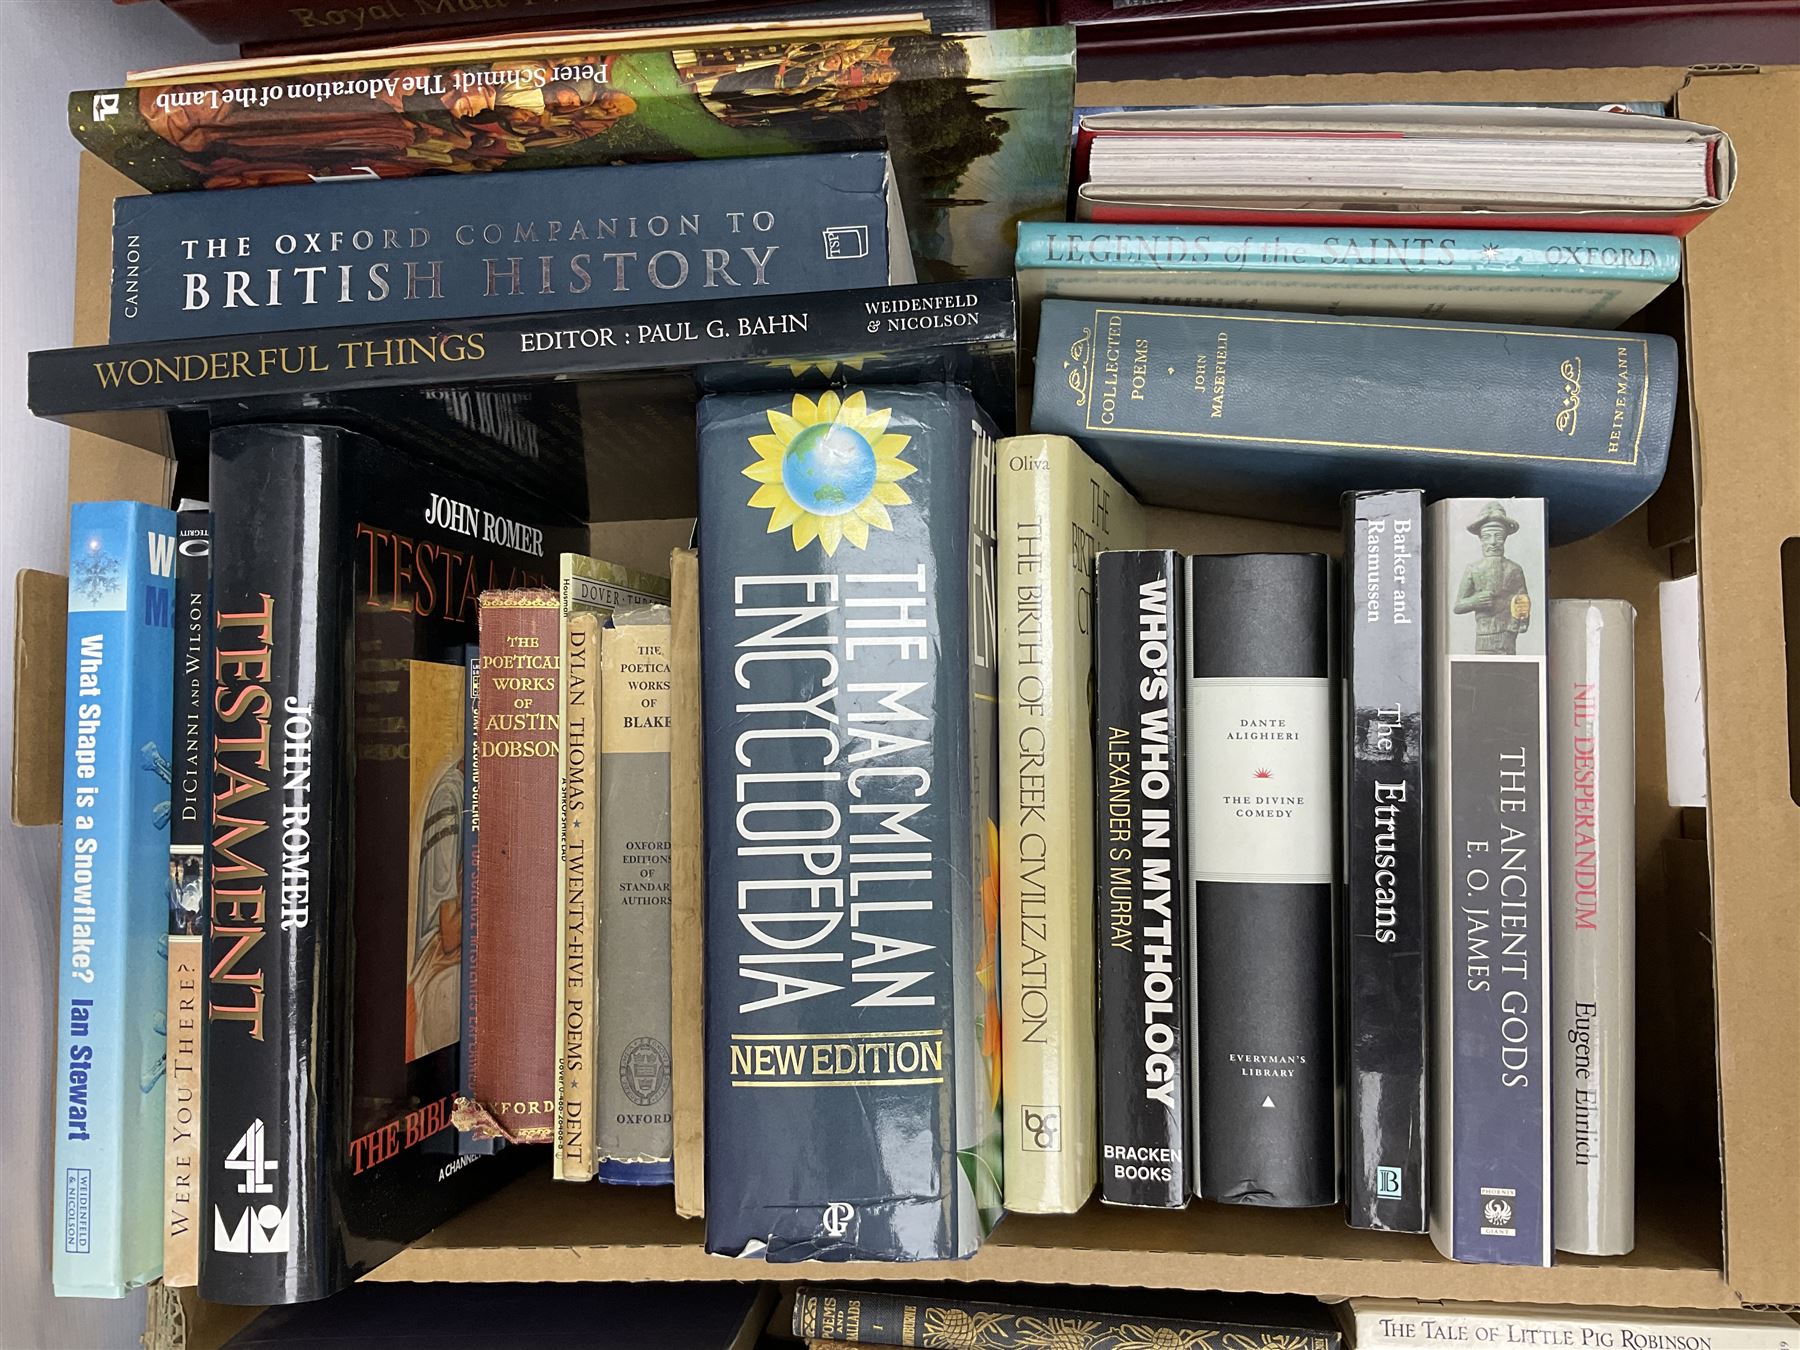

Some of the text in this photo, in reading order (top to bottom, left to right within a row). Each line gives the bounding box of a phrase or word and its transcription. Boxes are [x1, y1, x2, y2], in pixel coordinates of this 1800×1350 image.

[289, 0, 406, 31] Royal
[156, 64, 608, 114] Peter Schmidt The Adoration of the Lamb
[181, 211, 775, 260] THE OXFORD COMPANION TO
[828, 232, 841, 257] TSP
[1046, 233, 1657, 273] LEGENDS of the SAINTS OXFORD
[124, 234, 141, 318] CANNON
[182, 246, 779, 312] BRITISH HISTORY
[864, 294, 979, 316] WEIDENFELD
[866, 312, 980, 333] & NICOLSON
[94, 344, 330, 390] WONDERFUL
[337, 332, 486, 371] THINGS
[520, 326, 618, 353] EDITOR
[638, 320, 699, 344] PAUL
[706, 318, 731, 340] G.
[737, 313, 809, 337] BAHN
[1101, 315, 1123, 425] COLLECTED
[1130, 338, 1149, 401] POEMS
[1194, 354, 1207, 394] JOHN
[1210, 332, 1228, 419] MASEFIELD
[1607, 345, 1627, 455] HEINEMANN
[1009, 456, 1051, 472] Oliva
[424, 492, 545, 558] JOHN ROMER
[1090, 478, 1111, 535] THE
[1366, 518, 1386, 624] Rasmussen
[1393, 518, 1412, 625] Barker and
[563, 578, 571, 619] Housman
[581, 583, 620, 606] DOVER
[507, 636, 540, 649] THE
[638, 646, 662, 656] THE
[492, 677, 555, 691] WORKS
[620, 664, 671, 674] POETICA
[628, 680, 671, 691] WORKS
[182, 592, 202, 821] DICIANNI AND WILSON
[485, 714, 560, 731] AUSTIN
[514, 698, 533, 709] OF
[641, 698, 658, 708] OF
[1240, 719, 1286, 727] DANTE
[481, 740, 560, 757] DOBSON
[1227, 732, 1299, 740] ALIGHIERI
[734, 574, 845, 1014] ENCYCLOPEDIA
[845, 563, 937, 1007] THE MACMILLAN
[1016, 516, 1049, 1044] THE BIRTH OF GREEK CIVILIZATION
[1223, 796, 1305, 805] THE DIVINE
[208, 591, 274, 1042] TESTAMENT
[280, 696, 313, 931] JOHN ROMER
[1236, 809, 1293, 818] COMEDY
[1374, 702, 1406, 943] The Etruscans
[1573, 682, 1598, 931] NIL DESPERANDUM
[626, 841, 671, 850] OXFORD
[1108, 726, 1133, 953] ALEXANDER S MURRAY
[1139, 580, 1176, 1110] WHO'S WHO IN MYTHOLOGY
[66, 634, 104, 1142] What Shape is a Snowflake? Ian Stewart
[619, 882, 670, 891] STANDAR
[640, 869, 655, 878] OF
[566, 632, 585, 1164] DYLAN THOMAS TWENTY-FIVE POEMS DENT
[1461, 840, 1490, 993] E. O. JAMES
[1499, 746, 1528, 1087] THE ANCIENT GODS
[730, 1041, 943, 1076] NEW EDITION
[1229, 1053, 1306, 1064] EVERYMAN'S
[1567, 1001, 1597, 1080] Eugene
[1242, 1068, 1295, 1077] LIBRARY
[170, 963, 196, 1238] WERE YOU THERE?
[616, 1114, 672, 1125] OXFORD
[350, 1119, 400, 1177] THE
[1104, 1145, 1183, 1163] BRACKEN
[438, 1167, 446, 1183] A
[1114, 1165, 1172, 1181] BOOKS
[1379, 1168, 1399, 1193] B
[66, 1176, 77, 1246] & NICOLSON
[79, 1176, 88, 1247] WEIDENFELD
[822, 1297, 837, 1339] POEMS
[1379, 1318, 1713, 1350] THE TALE OF LITTLE PIG ROBINSON
